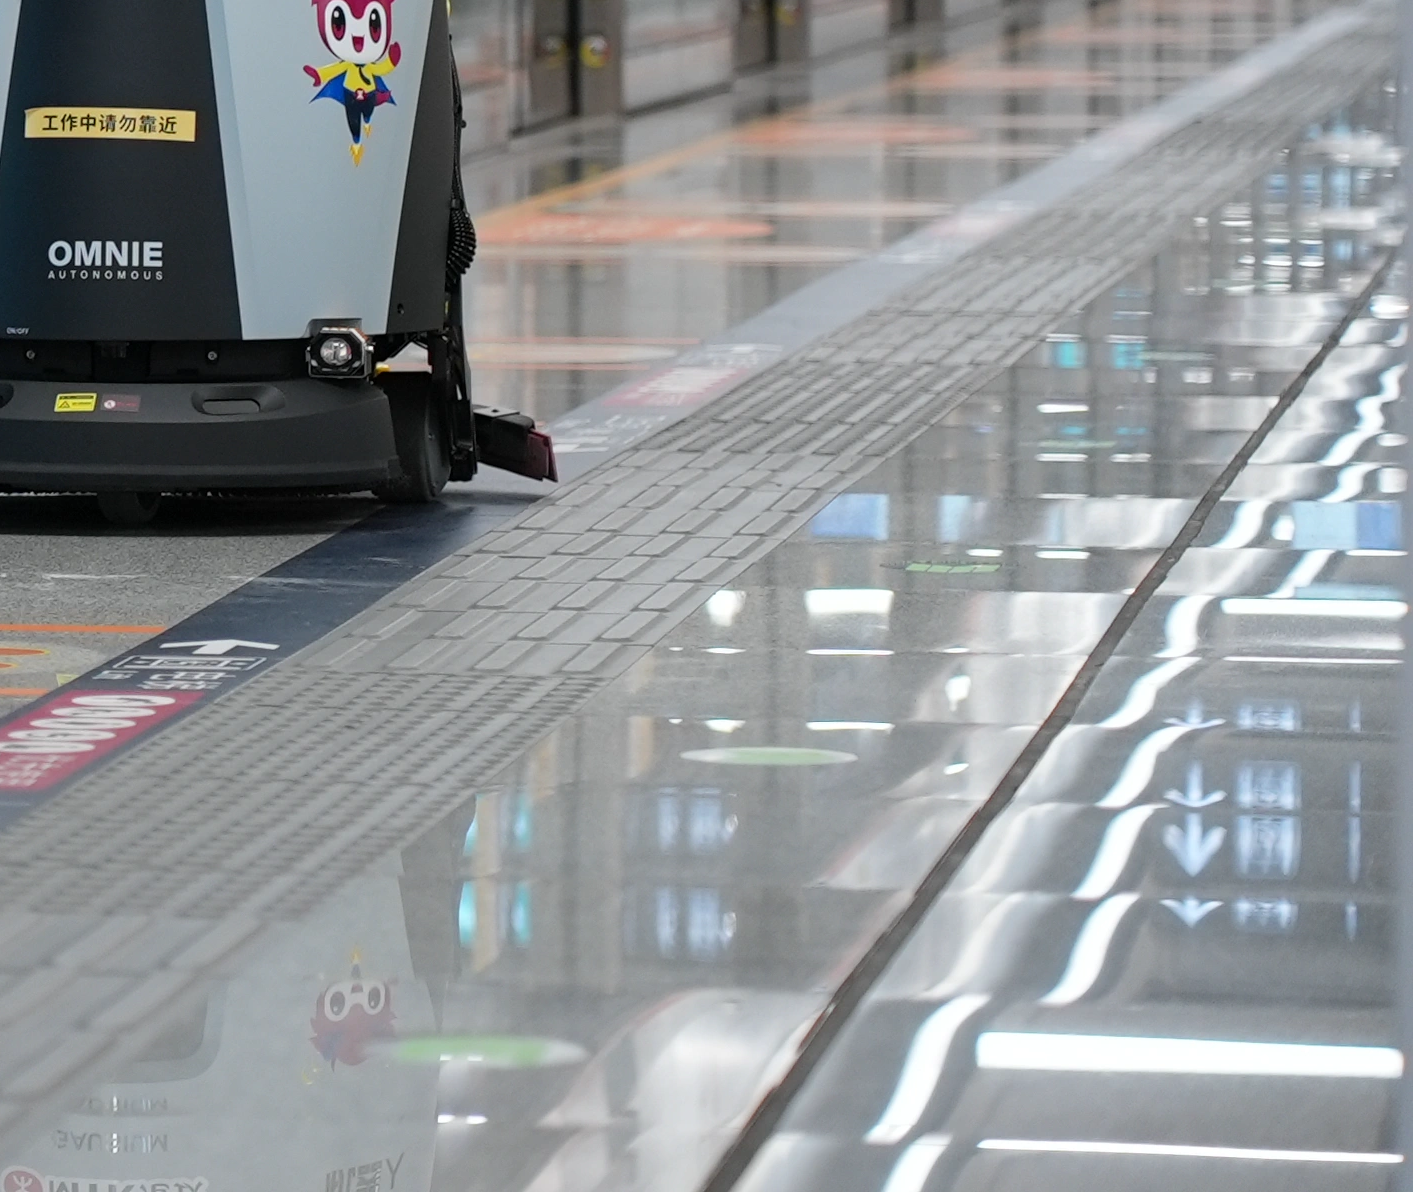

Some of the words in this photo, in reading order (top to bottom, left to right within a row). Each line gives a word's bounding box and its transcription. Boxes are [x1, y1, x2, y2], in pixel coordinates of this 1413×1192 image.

[42, 113, 178, 135] 工作中请勿靠近
[47, 240, 164, 268] OMNIE
[47, 269, 164, 281] AUTONOMOUS
